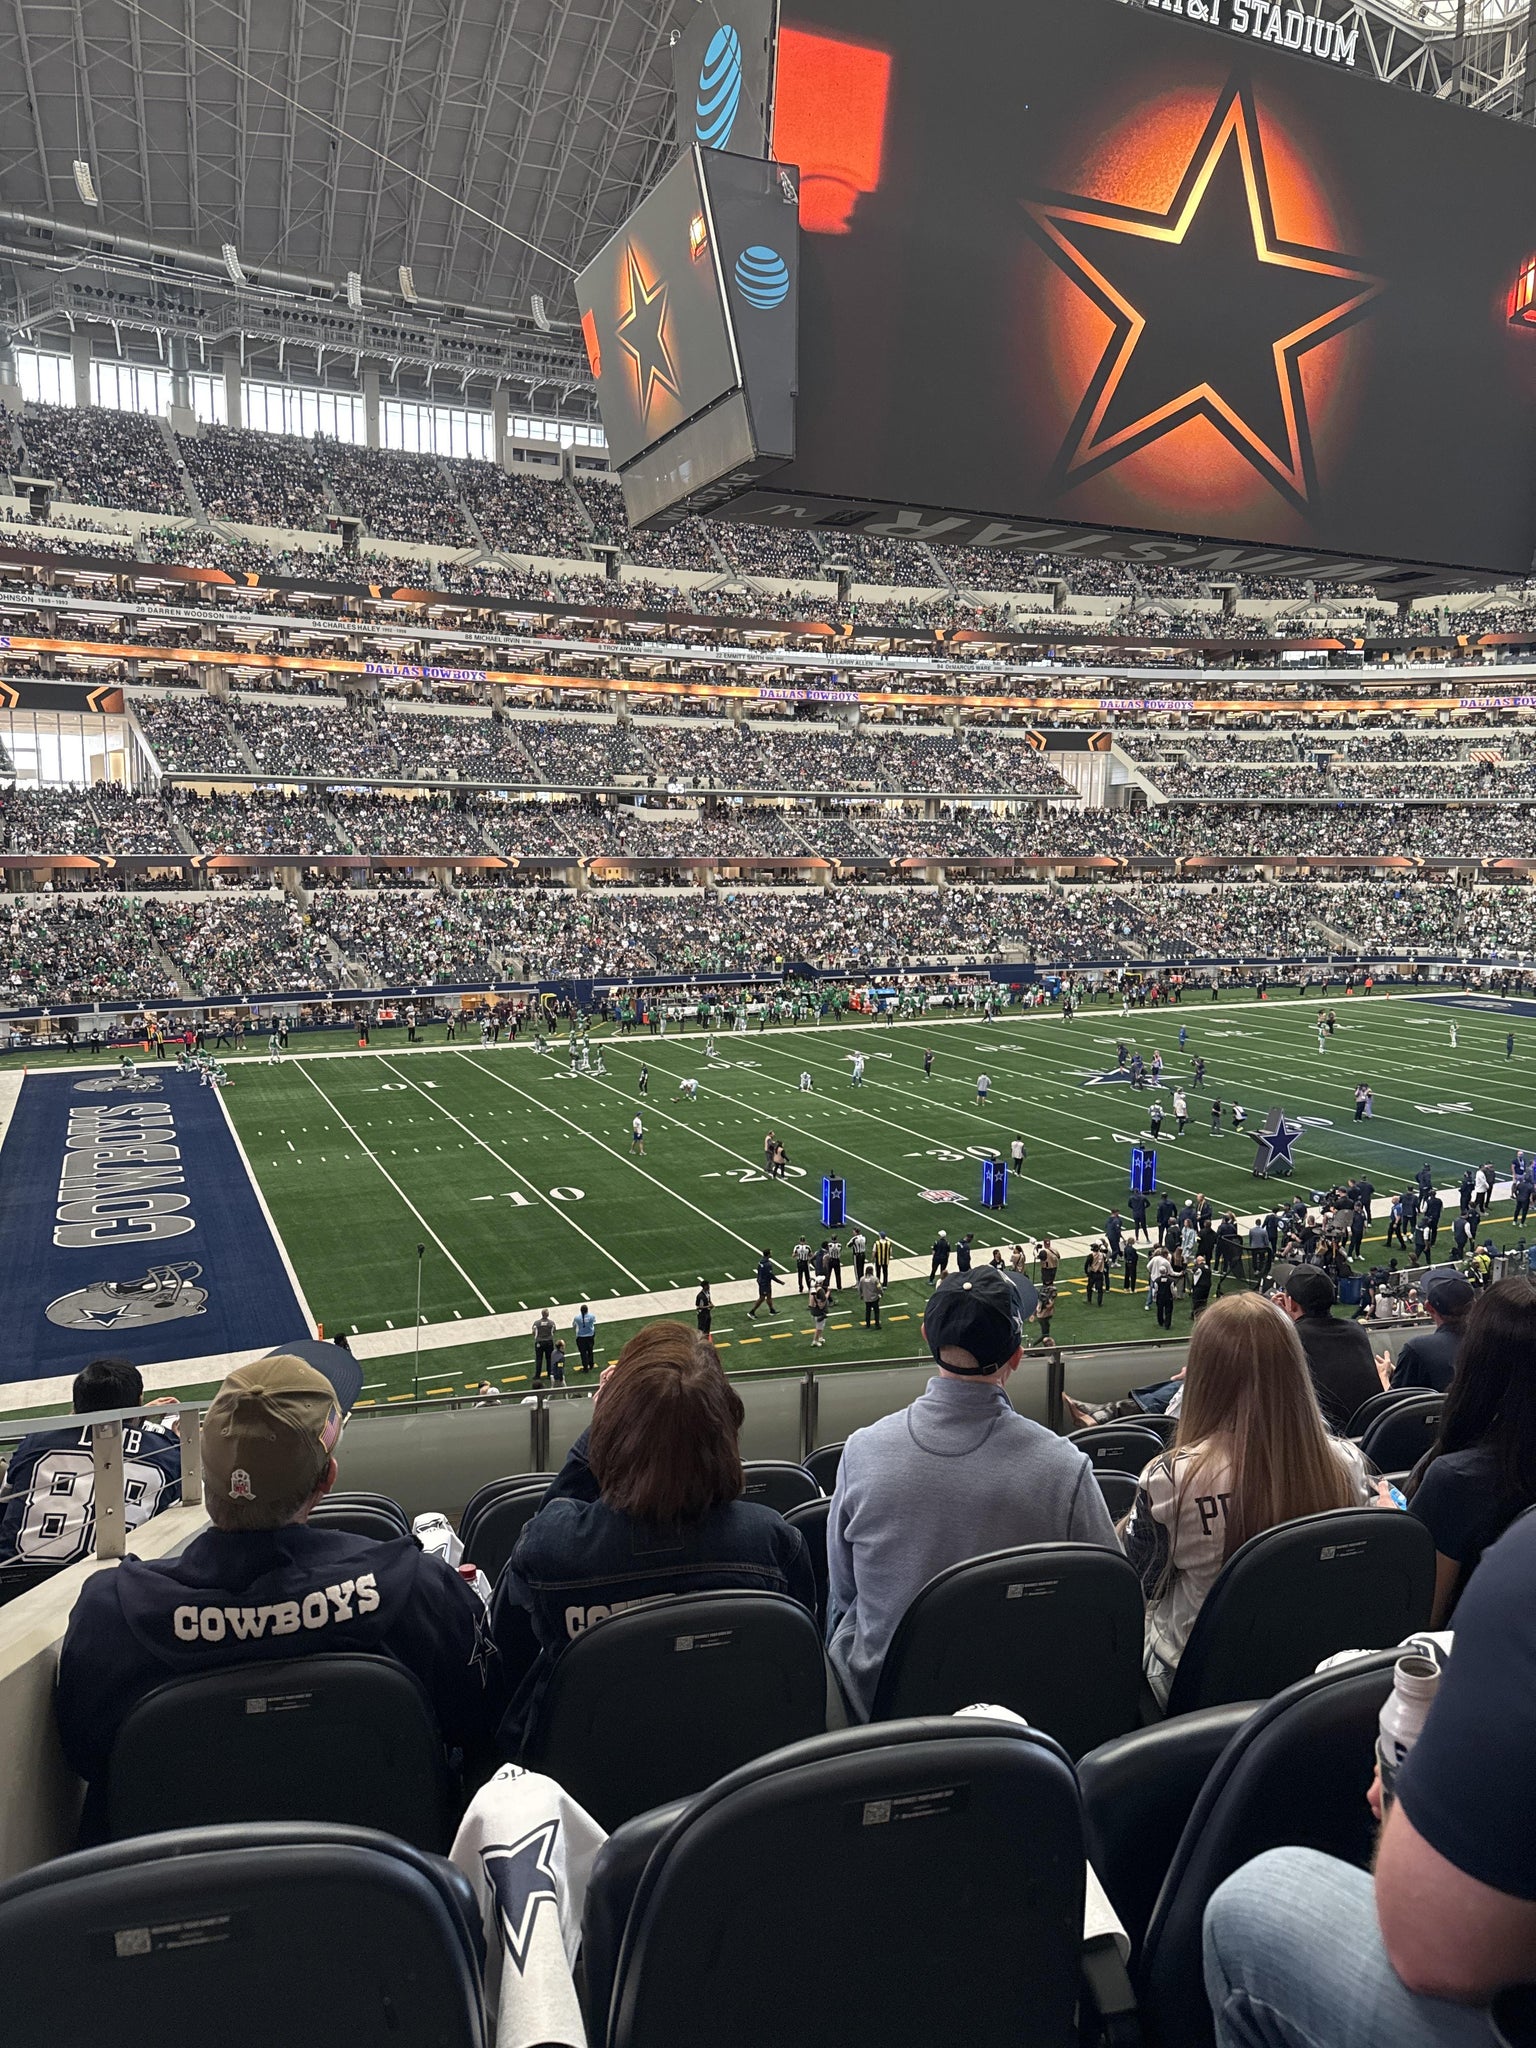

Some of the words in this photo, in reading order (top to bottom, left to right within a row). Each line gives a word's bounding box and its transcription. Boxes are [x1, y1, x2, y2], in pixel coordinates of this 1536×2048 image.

[1148, 0, 1219, 25] &T
[1231, 0, 1358, 66] STADIUM
[863, 510, 1398, 582] WINSTAR
[147, 607, 181, 616] DARREN
[184, 610, 224, 619] WOODSON
[323, 621, 356, 630] CHARLES
[365, 663, 419, 675] DALLAS
[422, 666, 486, 680] COWBOYS
[760, 689, 804, 699] DALLAS
[806, 690, 859, 700] COWBOYS
[1460, 698, 1510, 707] DALLAS
[1100, 700, 1141, 709] DALLAS
[1144, 700, 1194, 709] COWBOYS
[925, 1145, 1002, 1162] 30
[53, 1102, 196, 1248] COWBOYS
[77, 1424, 143, 1454] LB
[174, 1573, 381, 1642] COWBOYS
